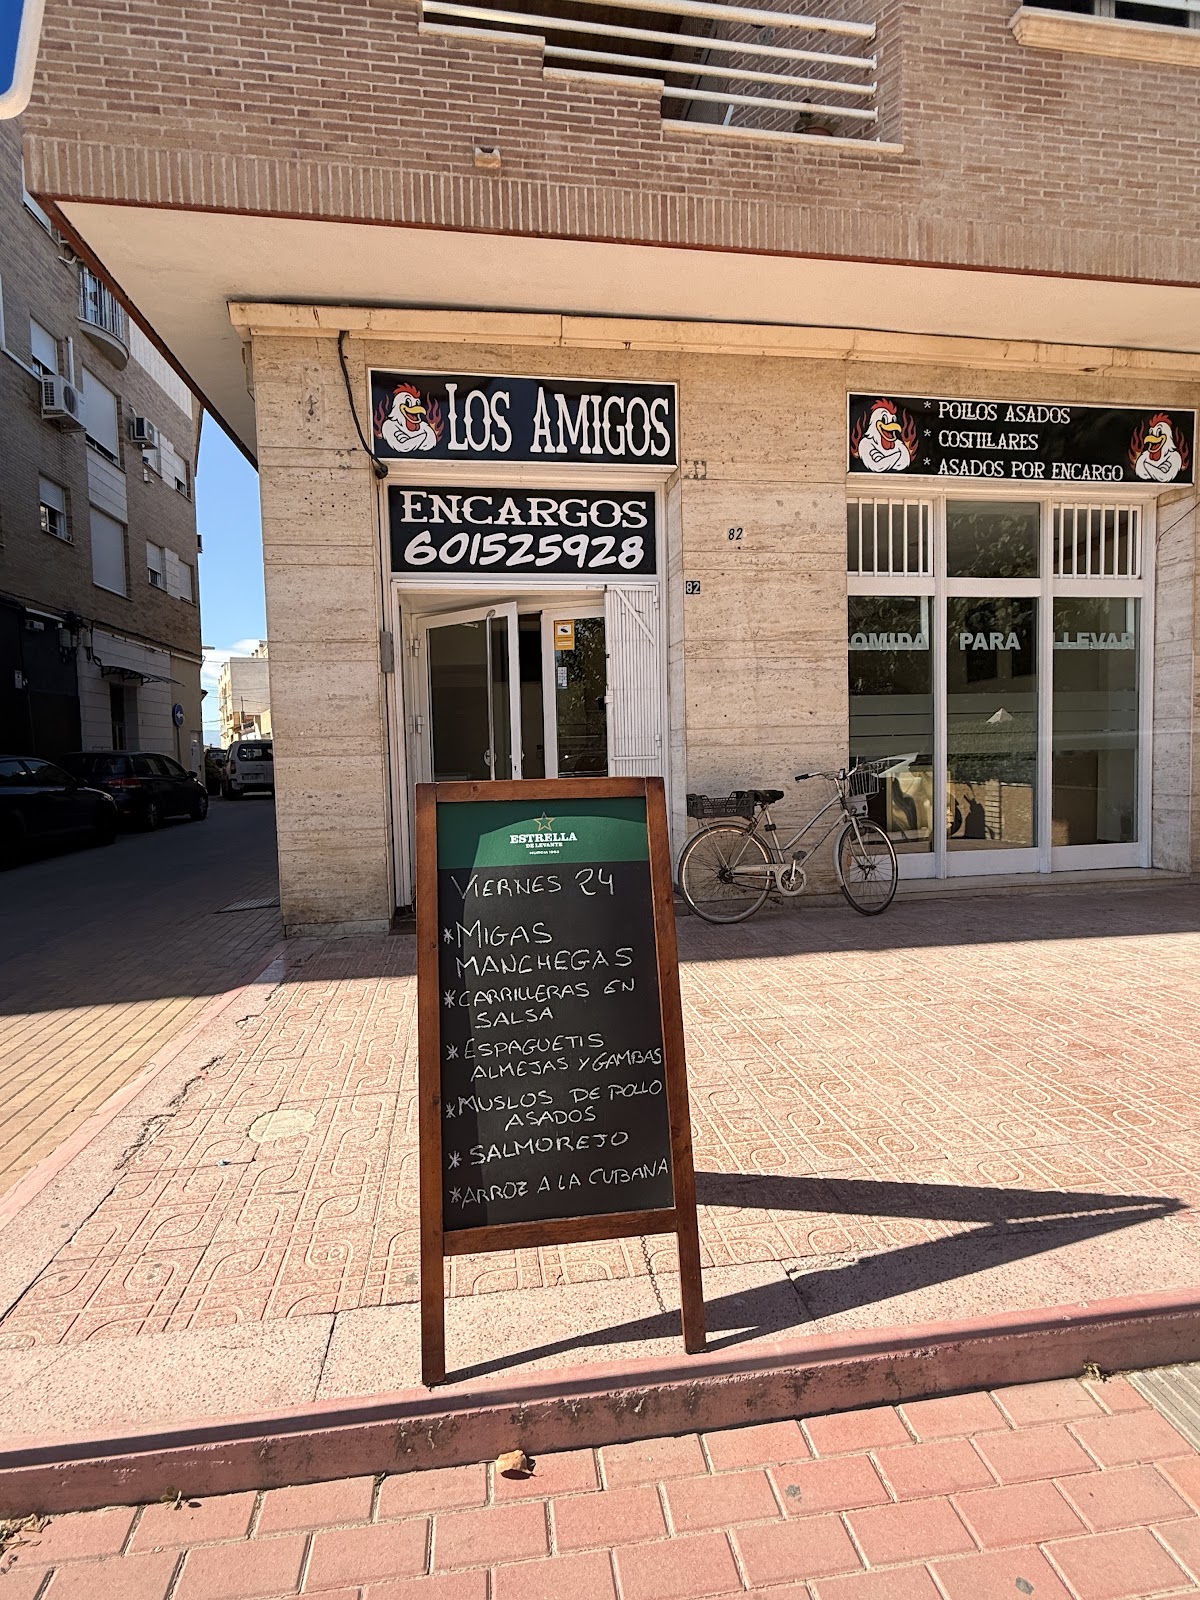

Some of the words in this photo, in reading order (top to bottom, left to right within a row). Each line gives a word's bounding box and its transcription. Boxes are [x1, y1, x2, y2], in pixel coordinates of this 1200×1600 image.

[445, 383, 513, 453] LOS
[530, 386, 671, 457] AMIGOS
[938, 401, 998, 421] POLLOS
[1004, 405, 1071, 424] ASADOS
[938, 430, 1039, 451] COSTILLARES
[938, 458, 1004, 477] ASADOS
[1011, 461, 1046, 479] POR
[1051, 462, 1124, 481] ENCARGO
[399, 490, 648, 528] ENCARGOS
[728, 527, 743, 541] 82
[404, 530, 644, 569] 601525928
[686, 581, 700, 594] 82
[848, 632, 928, 650] OMIDA
[960, 632, 1021, 650] PARA
[509, 832, 578, 844] ESTRELLA
[451, 874, 562, 900] VIERNES
[575, 868, 614, 896] 24
[455, 919, 552, 948] MIGAS
[455, 948, 633, 978] MANCHEGAS
[458, 982, 590, 1007] CARRILLERAS
[604, 977, 635, 995] EN
[475, 1007, 554, 1028] SALSA
[465, 1033, 605, 1060] ESPAGUETIS
[470, 1057, 569, 1082] ALMEJAS
[458, 1090, 553, 1115] MUSLOS
[568, 1087, 601, 1104] DE
[607, 1079, 662, 1101] POLLO
[504, 1106, 596, 1131] ASADOS
[469, 1131, 629, 1165] SALMOREJO
[462, 1180, 528, 1209] ARROZ
[537, 1176, 550, 1194] A
[558, 1173, 581, 1190] LA
[588, 1158, 668, 1185] CUBANA
